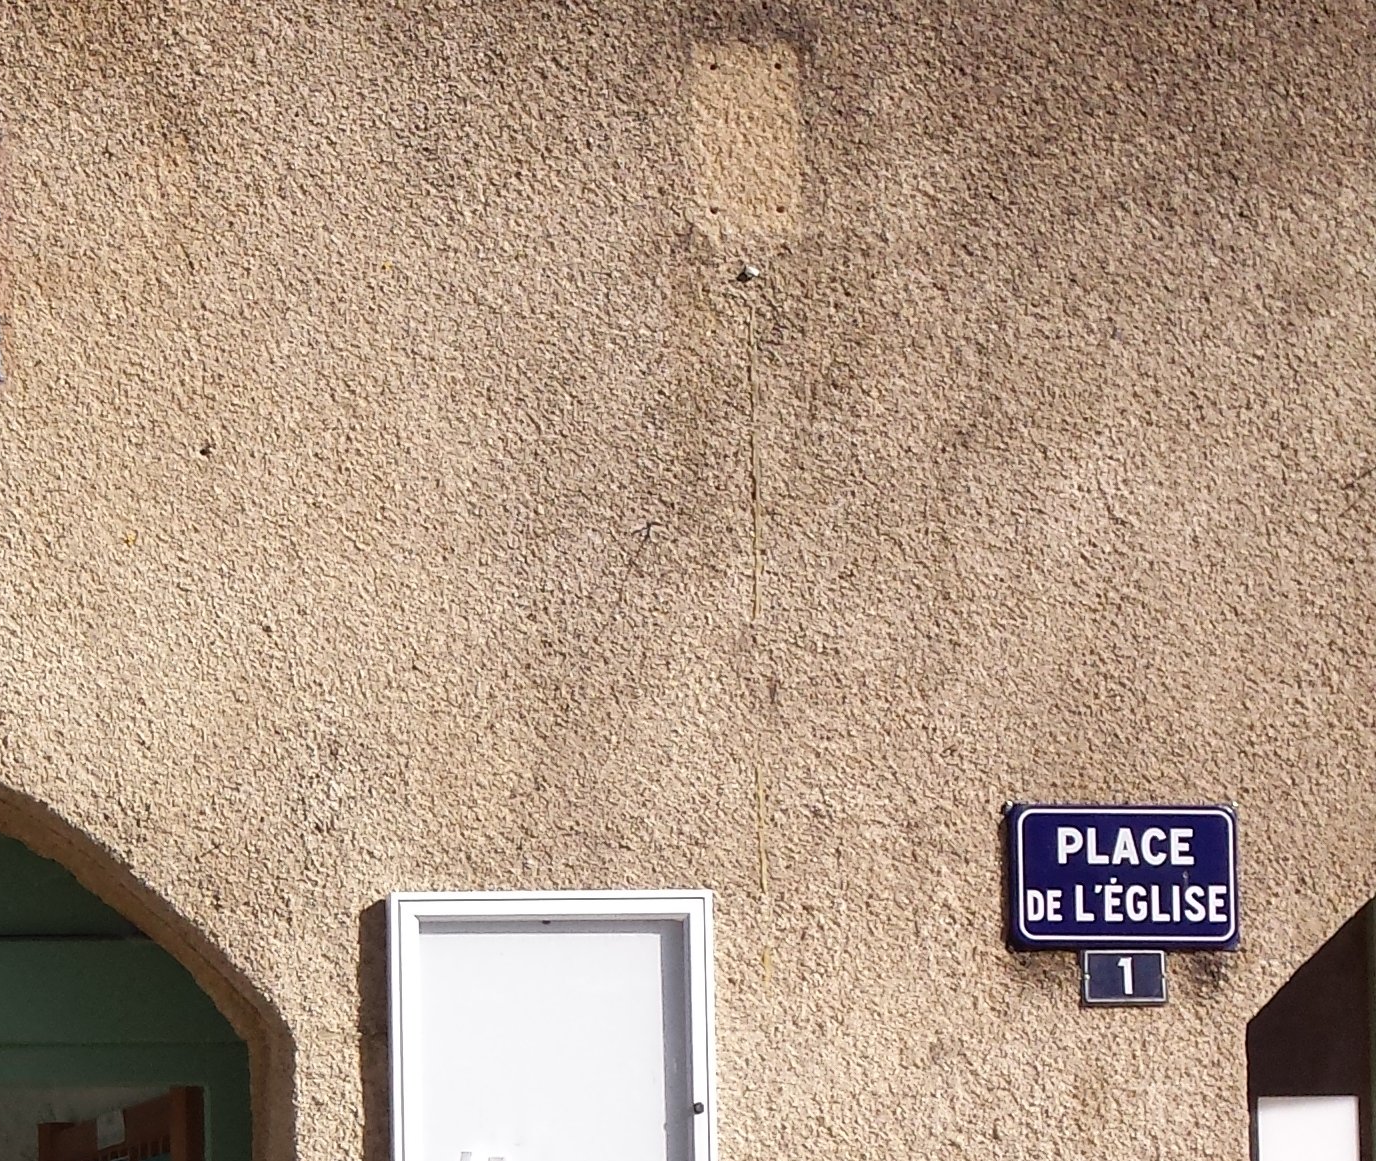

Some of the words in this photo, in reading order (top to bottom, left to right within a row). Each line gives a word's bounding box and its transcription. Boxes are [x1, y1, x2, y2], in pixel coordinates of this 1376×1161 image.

[1056, 826, 1195, 866] PLACE
[1027, 889, 1063, 922] DE
[1074, 877, 1228, 922] L'ÉGLISE
[1117, 957, 1134, 995] 1
